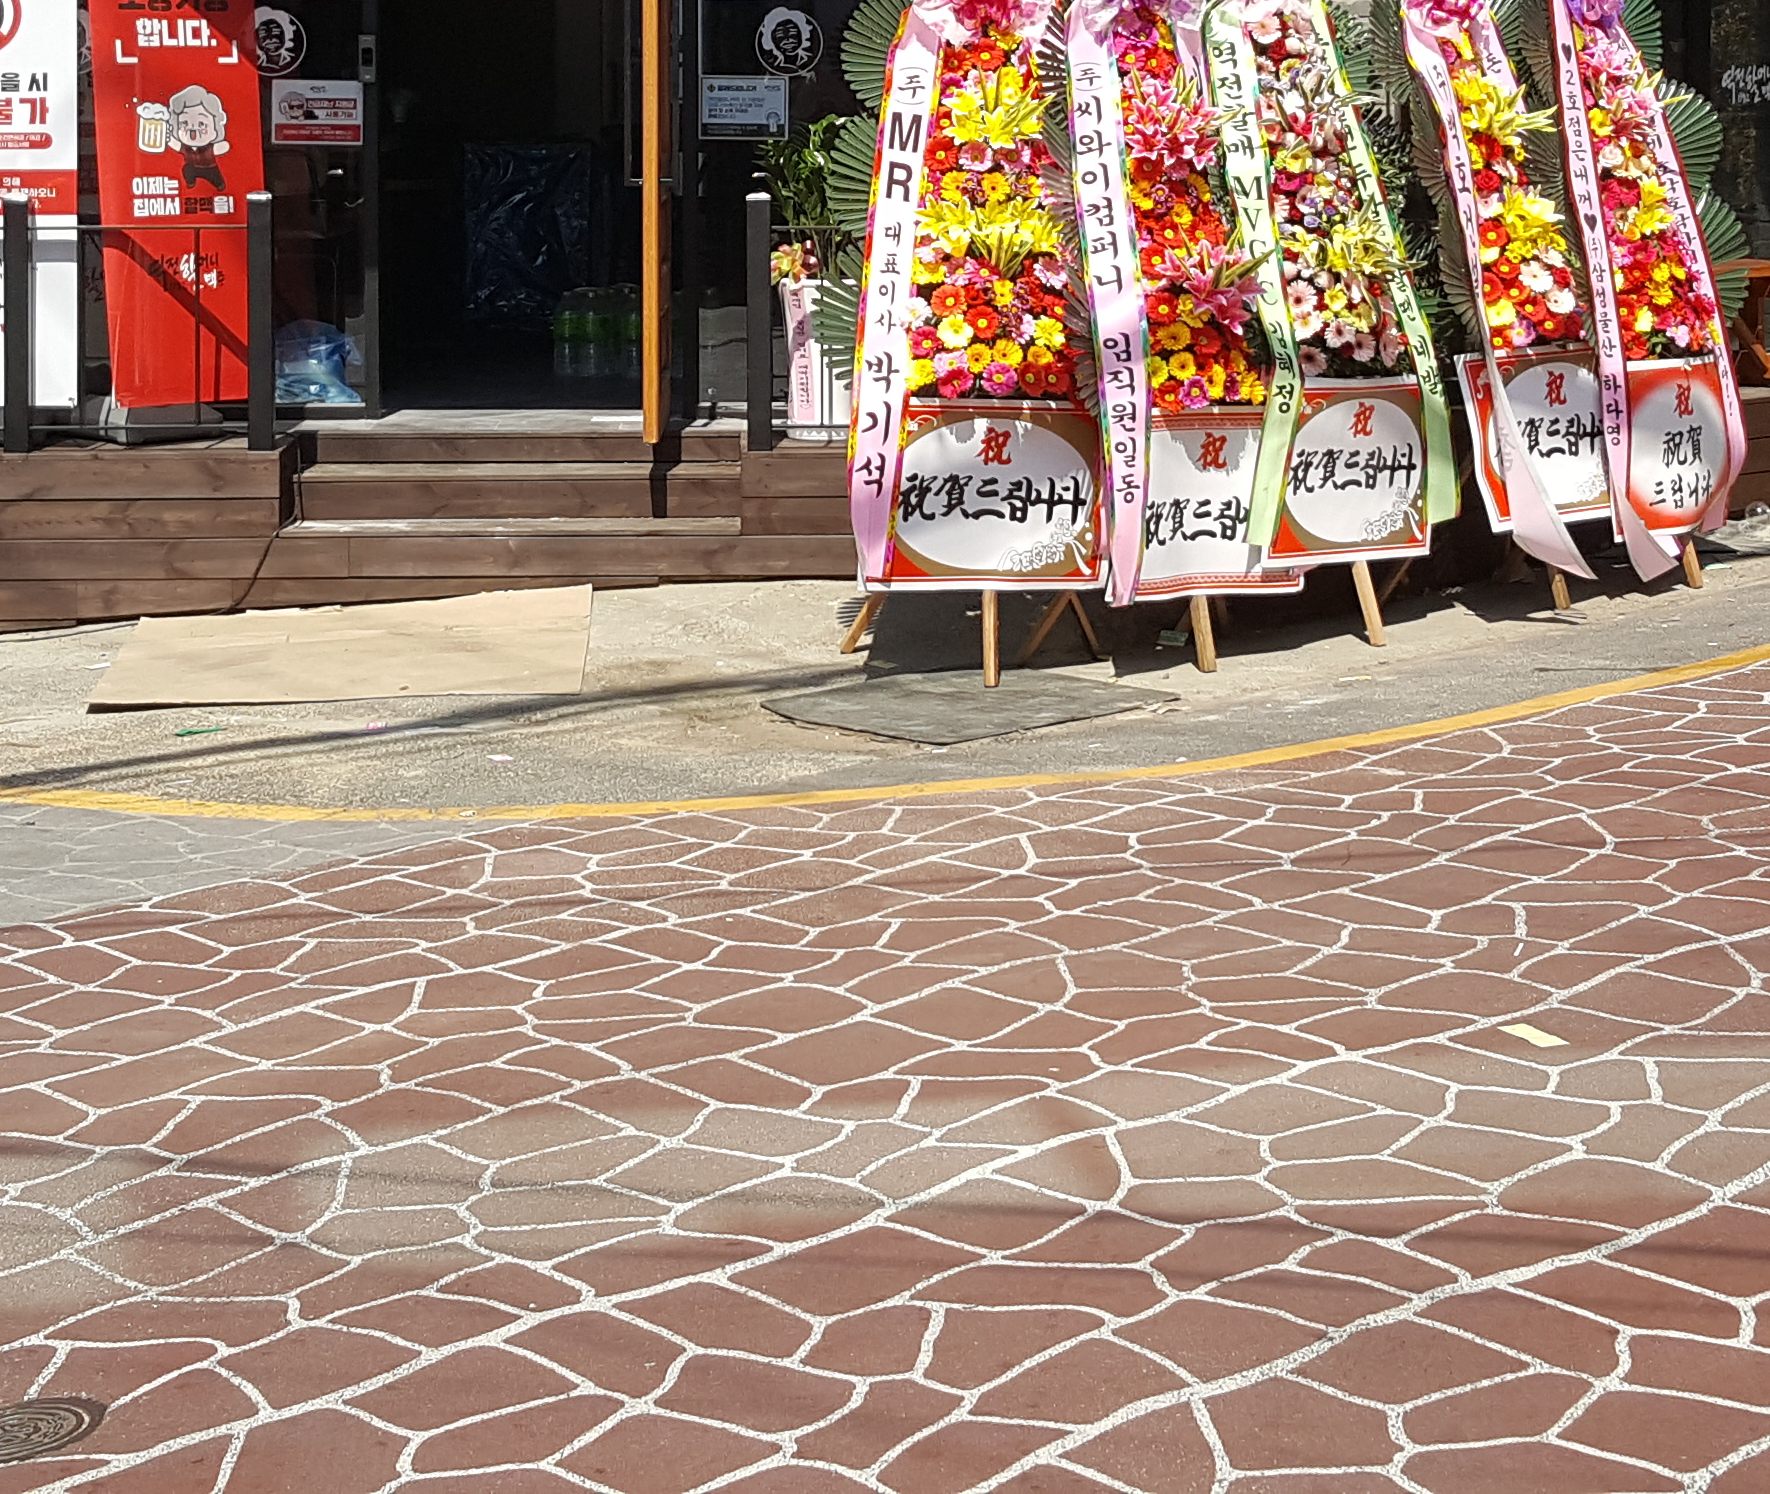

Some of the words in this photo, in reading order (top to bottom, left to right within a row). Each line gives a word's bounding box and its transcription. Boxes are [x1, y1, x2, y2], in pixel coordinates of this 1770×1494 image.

[136, 19, 217, 49] 합니다.
[28, 72, 49, 94] 시
[884, 111, 923, 204] MR
[132, 176, 180, 196] 이제는
[133, 197, 181, 217] 집에서
[874, 220, 902, 337] 대표이사
[1545, 369, 1570, 410] 祝
[1600, 372, 1626, 448] 하다영
[1674, 382, 1695, 420] 祝
[853, 353, 901, 501] 박기석
[1102, 332, 1143, 507] 임직원일동
[1349, 400, 1375, 440] 祝
[975, 426, 1013, 468] 祝
[1196, 429, 1229, 471] 祝
[1288, 441, 1418, 494] 祝賀드립니다
[1662, 426, 1704, 471] 祝賀
[897, 472, 1089, 526] 祝賀드립니다
